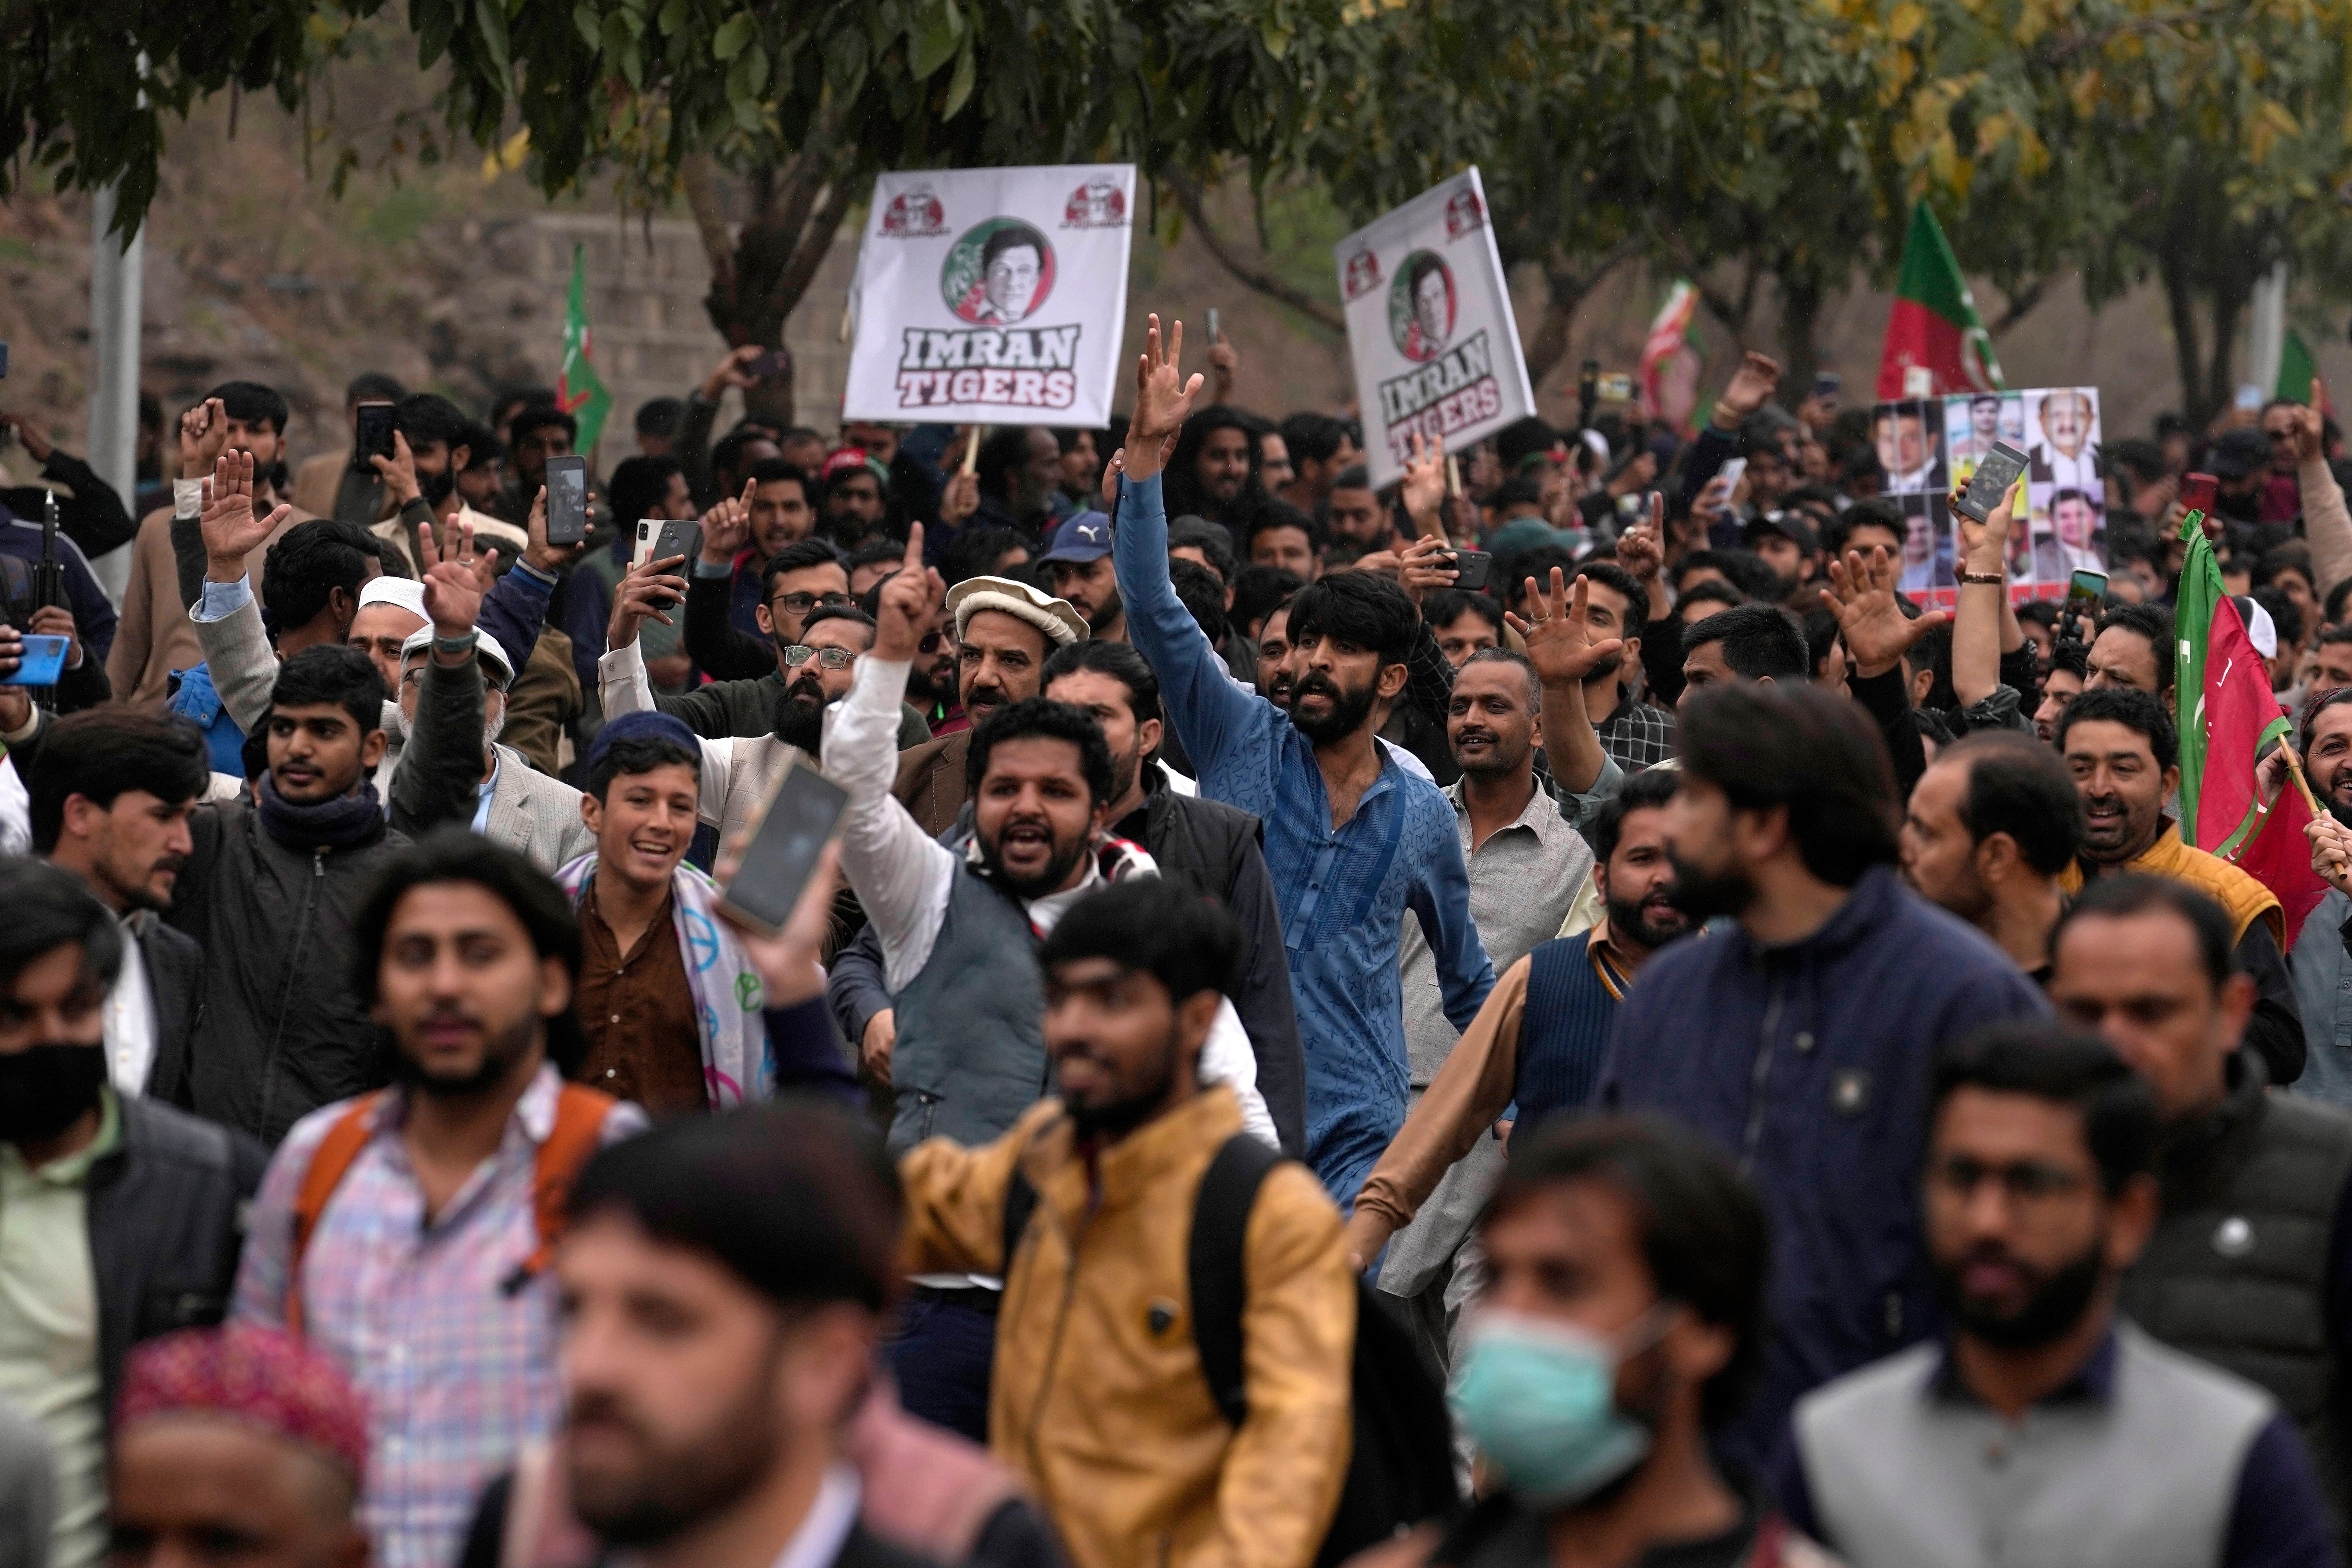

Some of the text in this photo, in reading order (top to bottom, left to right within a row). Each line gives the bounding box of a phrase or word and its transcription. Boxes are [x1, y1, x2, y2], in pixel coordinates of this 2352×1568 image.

[899, 324, 1081, 369] IMRAN
[897, 369, 1077, 409] TIGERS
[1378, 328, 1492, 426] IMRAN
